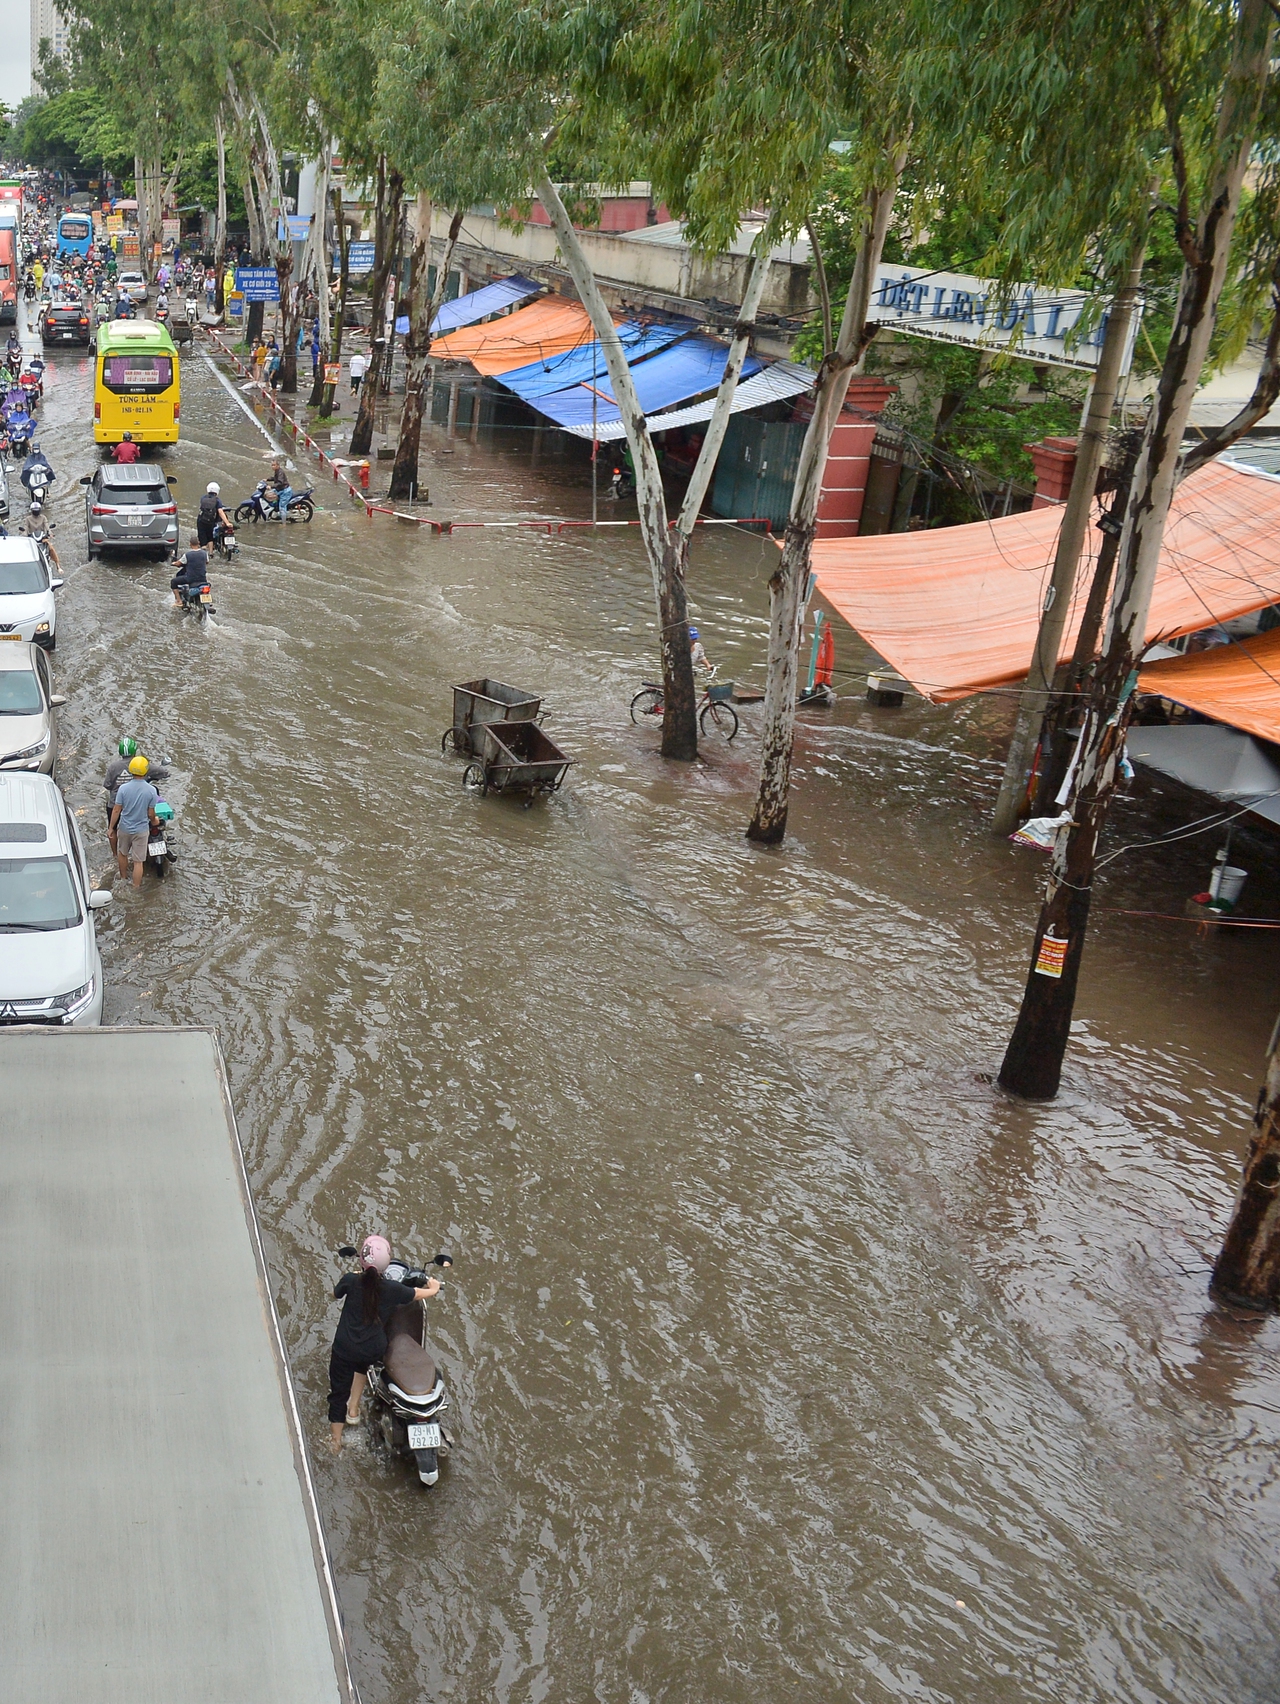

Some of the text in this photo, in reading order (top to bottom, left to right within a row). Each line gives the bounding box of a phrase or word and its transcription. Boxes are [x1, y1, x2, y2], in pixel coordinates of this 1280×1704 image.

[877, 273, 929, 317] DỆT
[930, 287, 989, 325] LEN
[119, 395, 138, 403] TÙNG
[411, 1436, 439, 1447] 792.28
